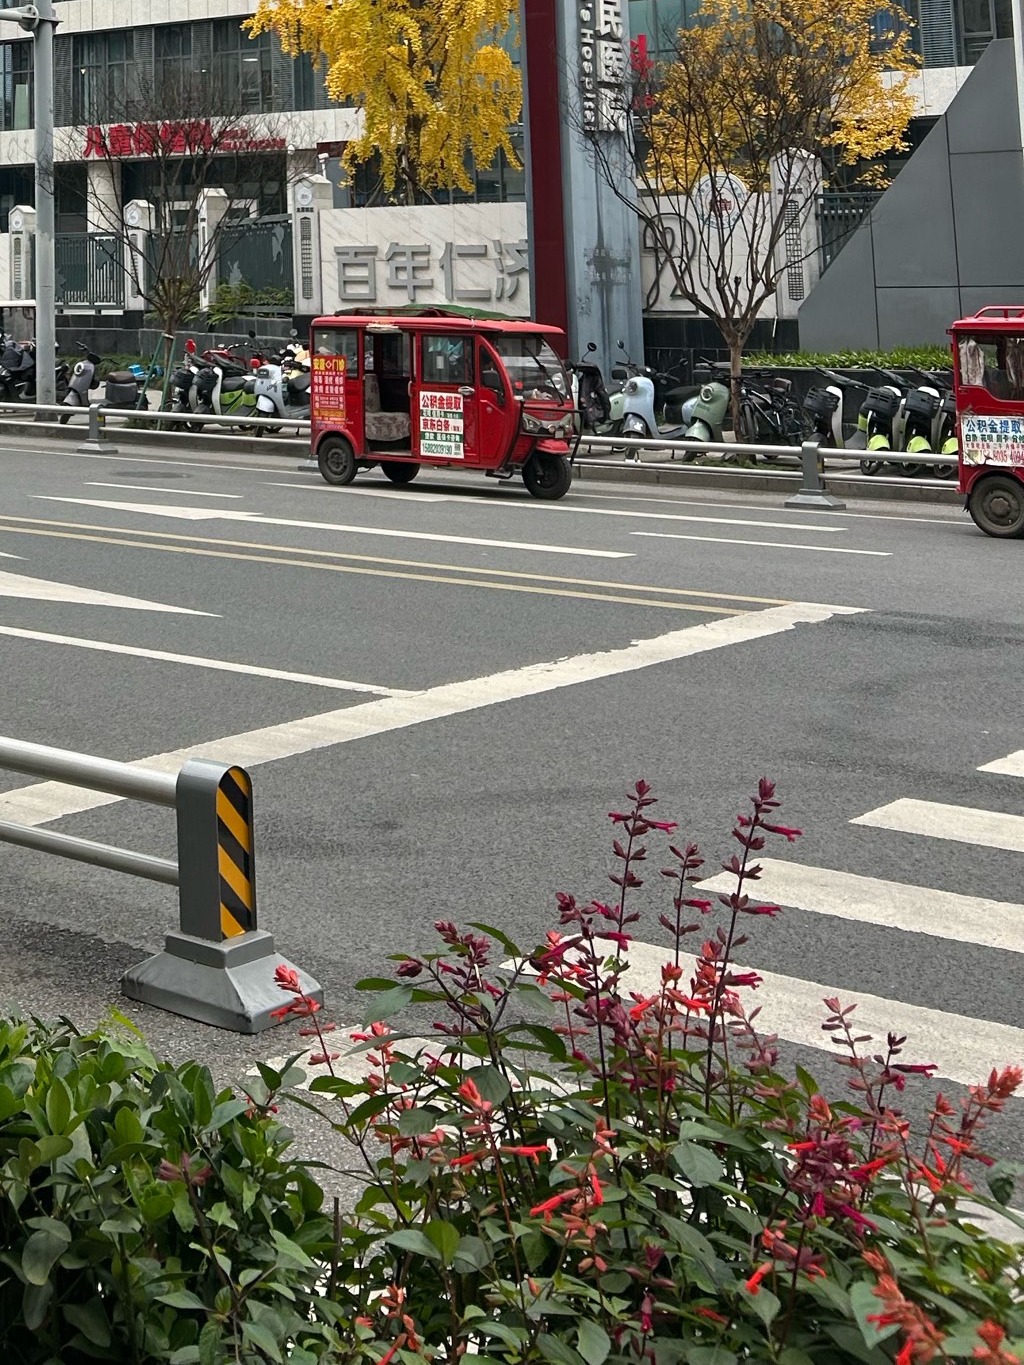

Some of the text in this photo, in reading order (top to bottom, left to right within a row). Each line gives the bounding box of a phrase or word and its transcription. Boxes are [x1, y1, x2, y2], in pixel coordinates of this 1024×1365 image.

[334, 239, 528, 301] 百年仁济
[422, 395, 462, 410] 公积金提取
[422, 418, 451, 432] 京东白条
[966, 419, 1022, 434] 公积金提取
